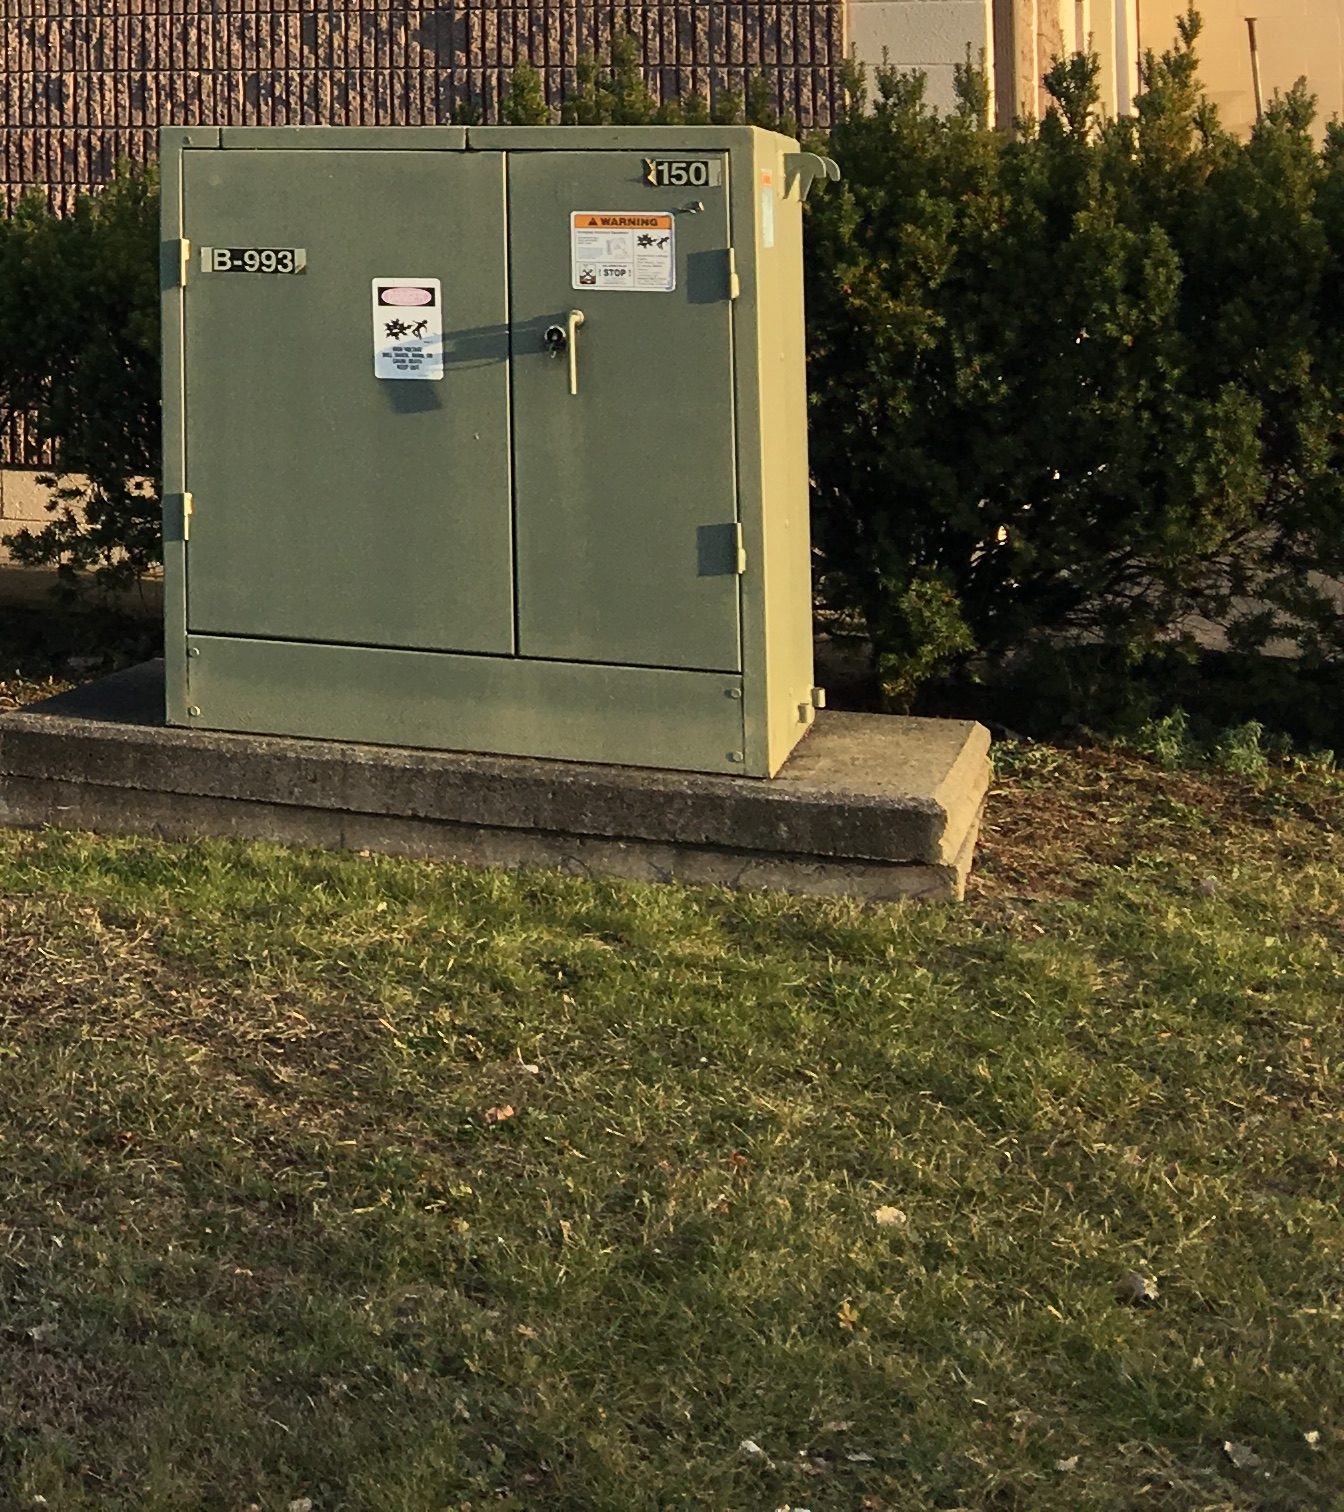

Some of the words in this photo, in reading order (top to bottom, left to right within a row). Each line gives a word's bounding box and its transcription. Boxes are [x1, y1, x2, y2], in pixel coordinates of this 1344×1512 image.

[657, 161, 707, 186] 150
[600, 217, 658, 227] WARNING
[213, 248, 294, 273] B-993
[603, 268, 627, 277] STOP
